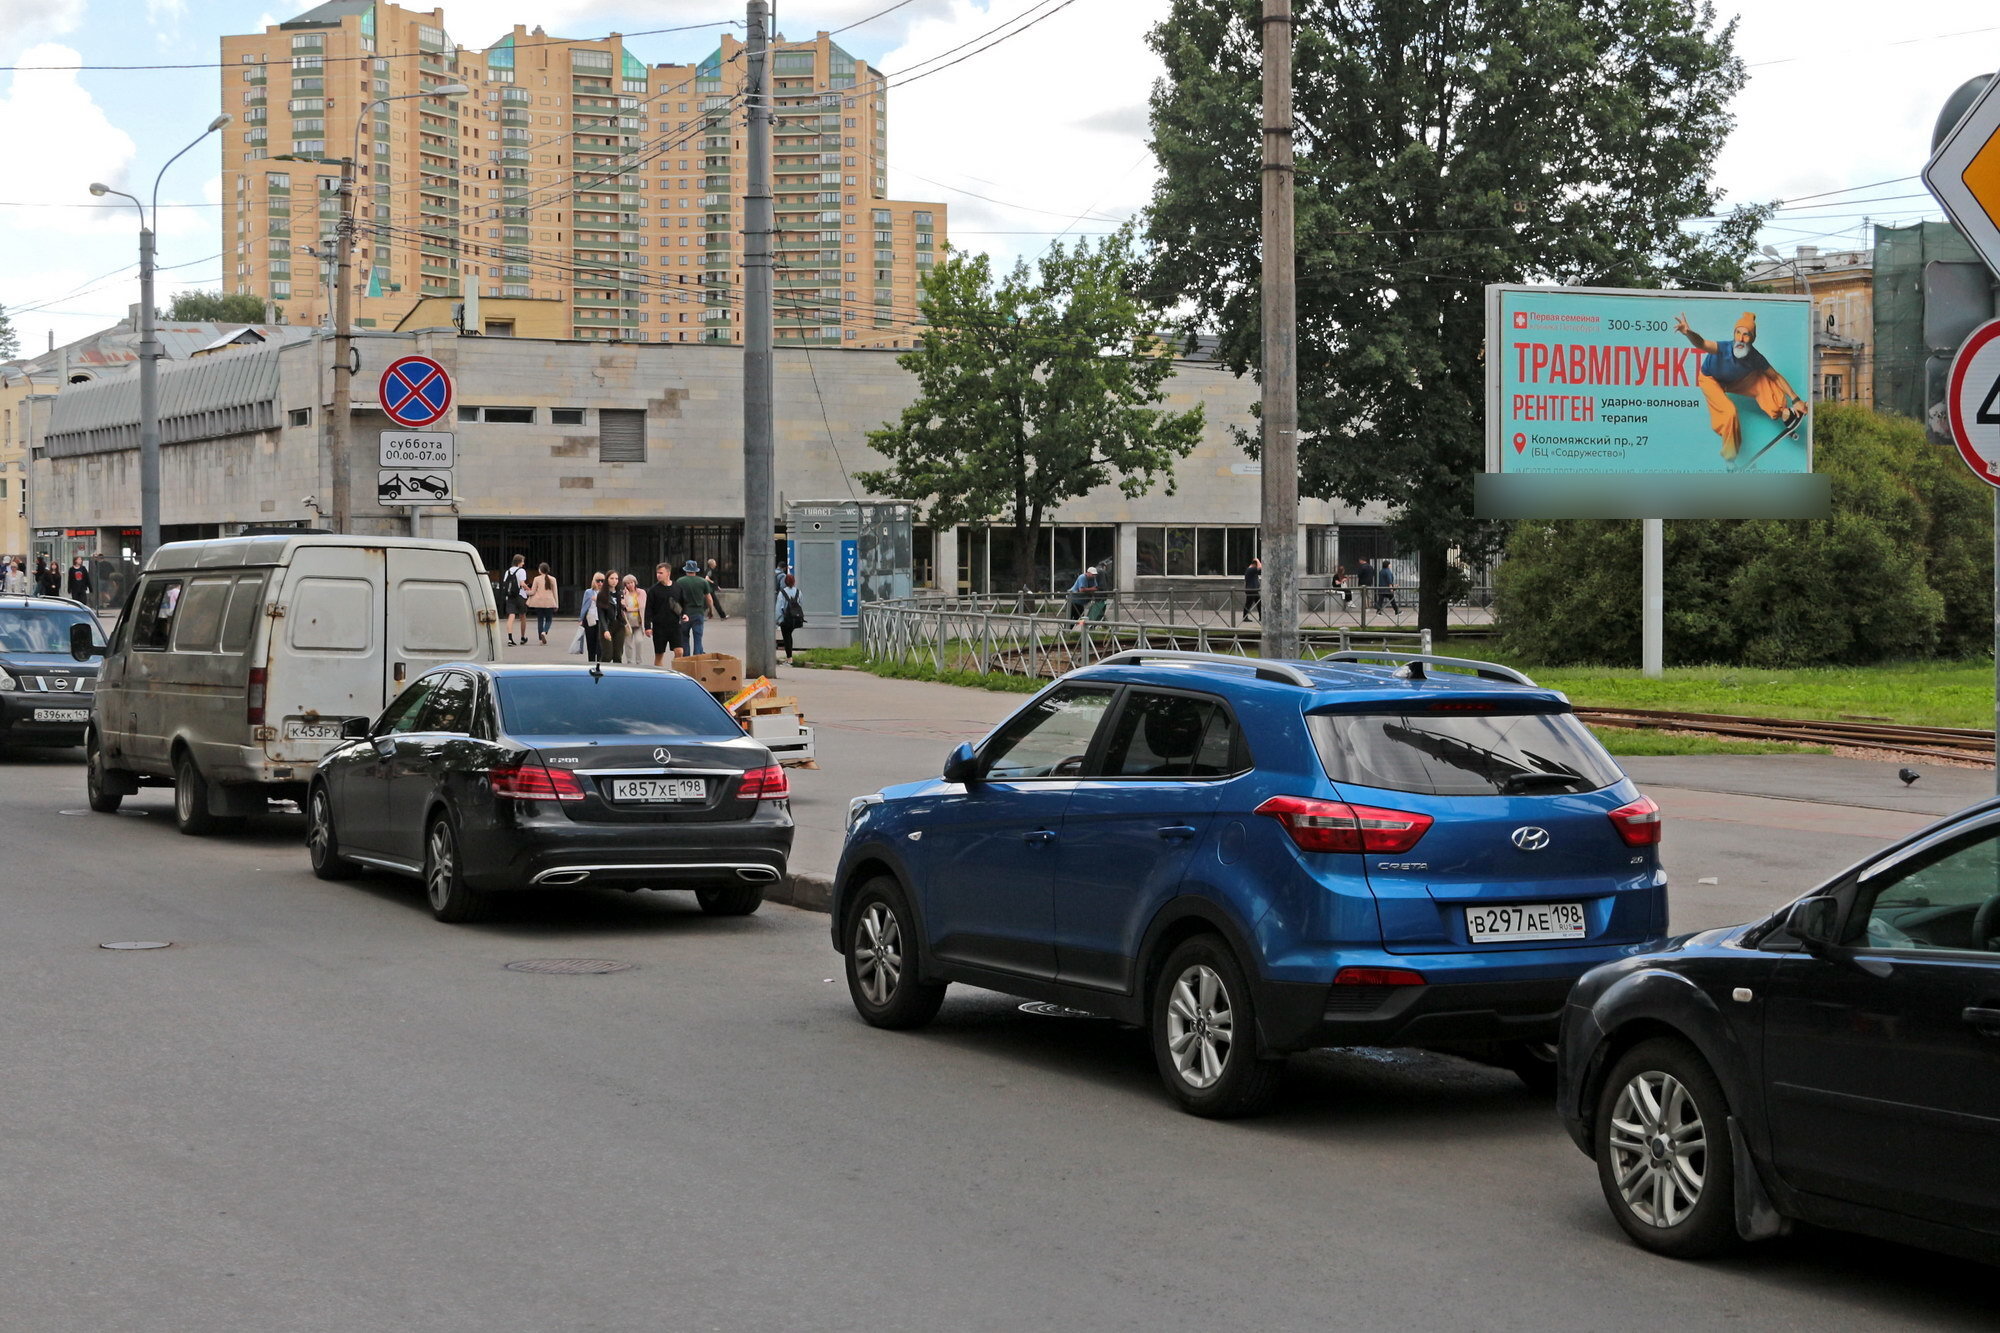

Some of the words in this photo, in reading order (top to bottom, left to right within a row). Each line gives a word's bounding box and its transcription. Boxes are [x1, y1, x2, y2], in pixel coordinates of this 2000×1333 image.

[1530, 311, 1559, 323] Первая
[1561, 314, 1600, 323] семейная
[1608, 320, 1668, 331] 300-5-300
[1514, 342, 1708, 387] ТРАВМПУНКТ
[1513, 394, 1594, 422] РЕНТГЕН
[1601, 397, 1699, 409] ударно-волновая
[1601, 413, 1648, 424] терапия
[390, 438, 442, 450] суббота
[1531, 434, 1611, 445] Коломяжский
[1614, 437, 1633, 447] пр.,
[1636, 436, 1648, 446] 27
[386, 450, 447, 461] 00.00-07.00
[1531, 448, 1549, 457] (БЦ
[1551, 448, 1626, 459] «Содружество»)
[847, 547, 855, 607] ТУАЛТ
[74, 710, 87, 718] 147
[292, 725, 339, 738] К453РХ
[618, 781, 677, 797] К857ХЕ
[680, 780, 701, 792] 198
[1377, 862, 1429, 870] CRETA
[1474, 908, 1550, 933] В297АЕ
[1552, 906, 1579, 923] 198
[1559, 923, 1573, 931] RUS
